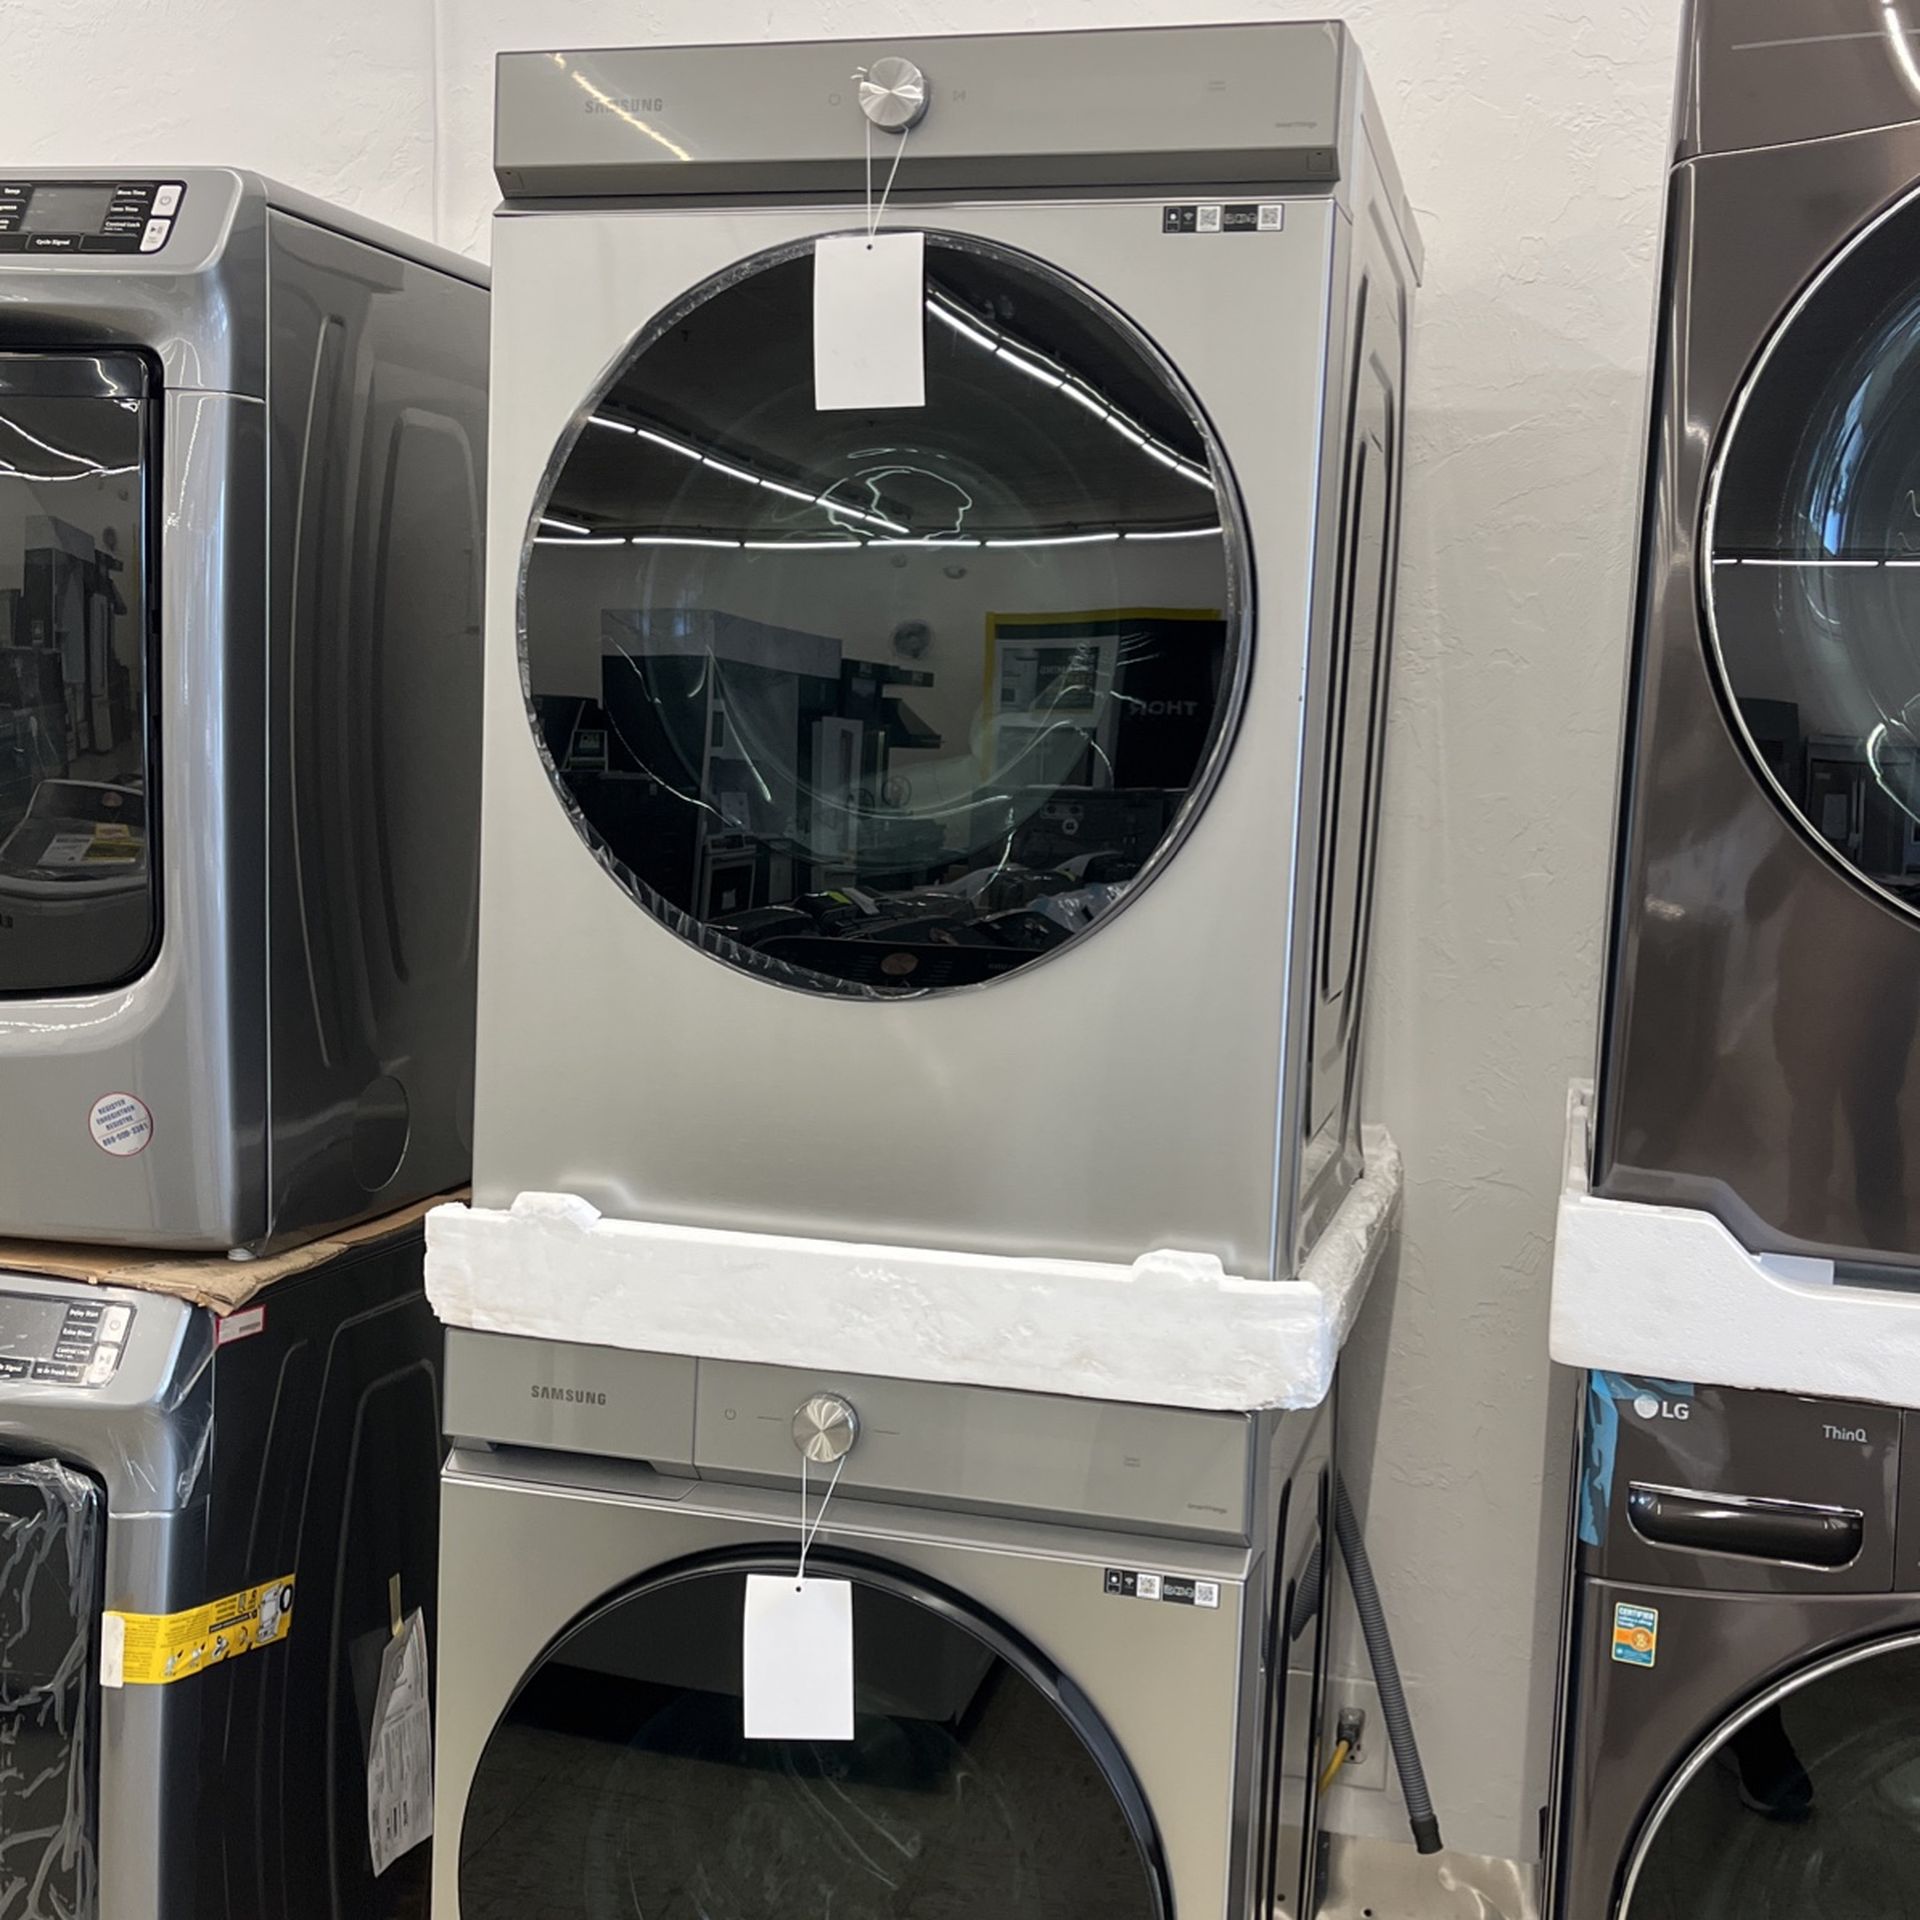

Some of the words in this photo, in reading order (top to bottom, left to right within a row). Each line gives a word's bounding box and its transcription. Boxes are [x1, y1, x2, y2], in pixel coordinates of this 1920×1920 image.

[531, 1384, 607, 1405] SAMSUNG
[1661, 1400, 1690, 1421] LG
[1822, 1424, 1868, 1443] ThinQ
